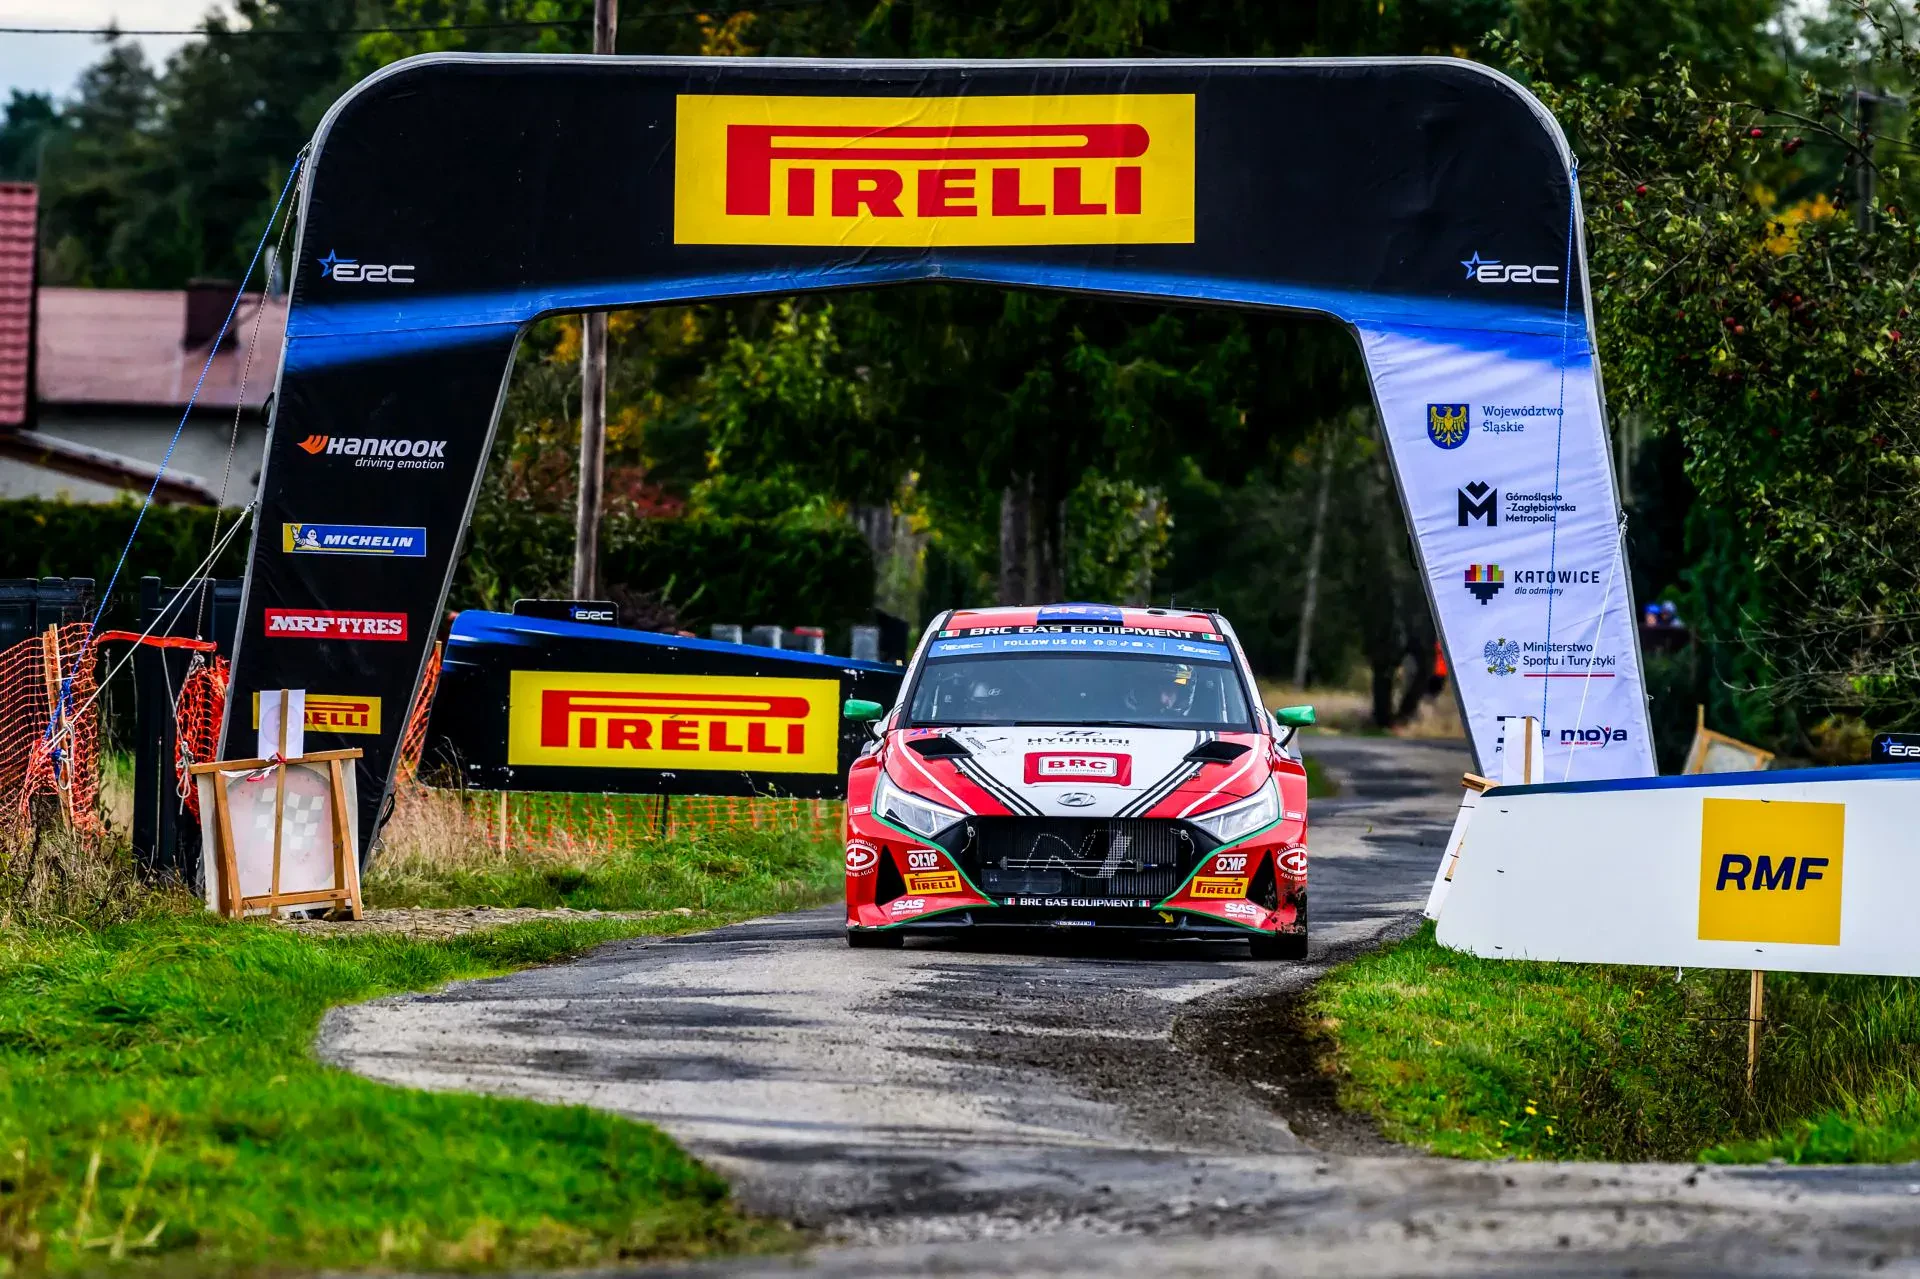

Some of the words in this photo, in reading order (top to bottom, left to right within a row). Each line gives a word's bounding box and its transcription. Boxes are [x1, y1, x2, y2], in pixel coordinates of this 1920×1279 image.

[726, 124, 1150, 217] PIRELLI
[333, 264, 415, 283] ERC
[1477, 265, 1560, 284] ERC
[1482, 405, 1564, 418] Województwo
[1482, 419, 1525, 435] Śląskie
[355, 457, 395, 471] driving
[397, 458, 445, 470] emotion
[1505, 492, 1563, 502] Górnośląsko
[323, 534, 414, 547] MICHELIN
[1514, 570, 1600, 584] KATOWICE
[1514, 586, 1526, 595] dla
[1528, 586, 1564, 597] odmiany
[575, 610, 614, 620] ERC
[269, 615, 335, 632] MRF
[337, 618, 402, 635] TYRES
[970, 626, 1013, 636] BRC
[1018, 625, 1063, 634] GAS
[1071, 626, 1194, 639] EQUIPMENT
[1003, 639, 1050, 647] FOLLOW
[1052, 638, 1068, 646] US
[1070, 638, 1087, 646] ON
[1523, 641, 1593, 652] Ministerstwo
[1523, 655, 1558, 667] Sportu
[1561, 655, 1565, 666] i
[1568, 655, 1616, 667] Turystyki
[541, 690, 811, 755] PIRELLI
[1561, 725, 1628, 748] moya
[1889, 745, 1920, 756] ER
[1048, 759, 1108, 769] BRC
[908, 853, 938, 868] OMP
[1216, 856, 1247, 872] OMP
[1715, 853, 1829, 891] RMF
[909, 875, 956, 891] PIRELLI
[1195, 881, 1244, 895] PIRELLI
[892, 899, 925, 910] SAS
[1020, 898, 1042, 906] BRC
[1045, 898, 1068, 907] GAS
[1071, 899, 1135, 907] EQUIPMENT
[1225, 903, 1257, 915] SAS
